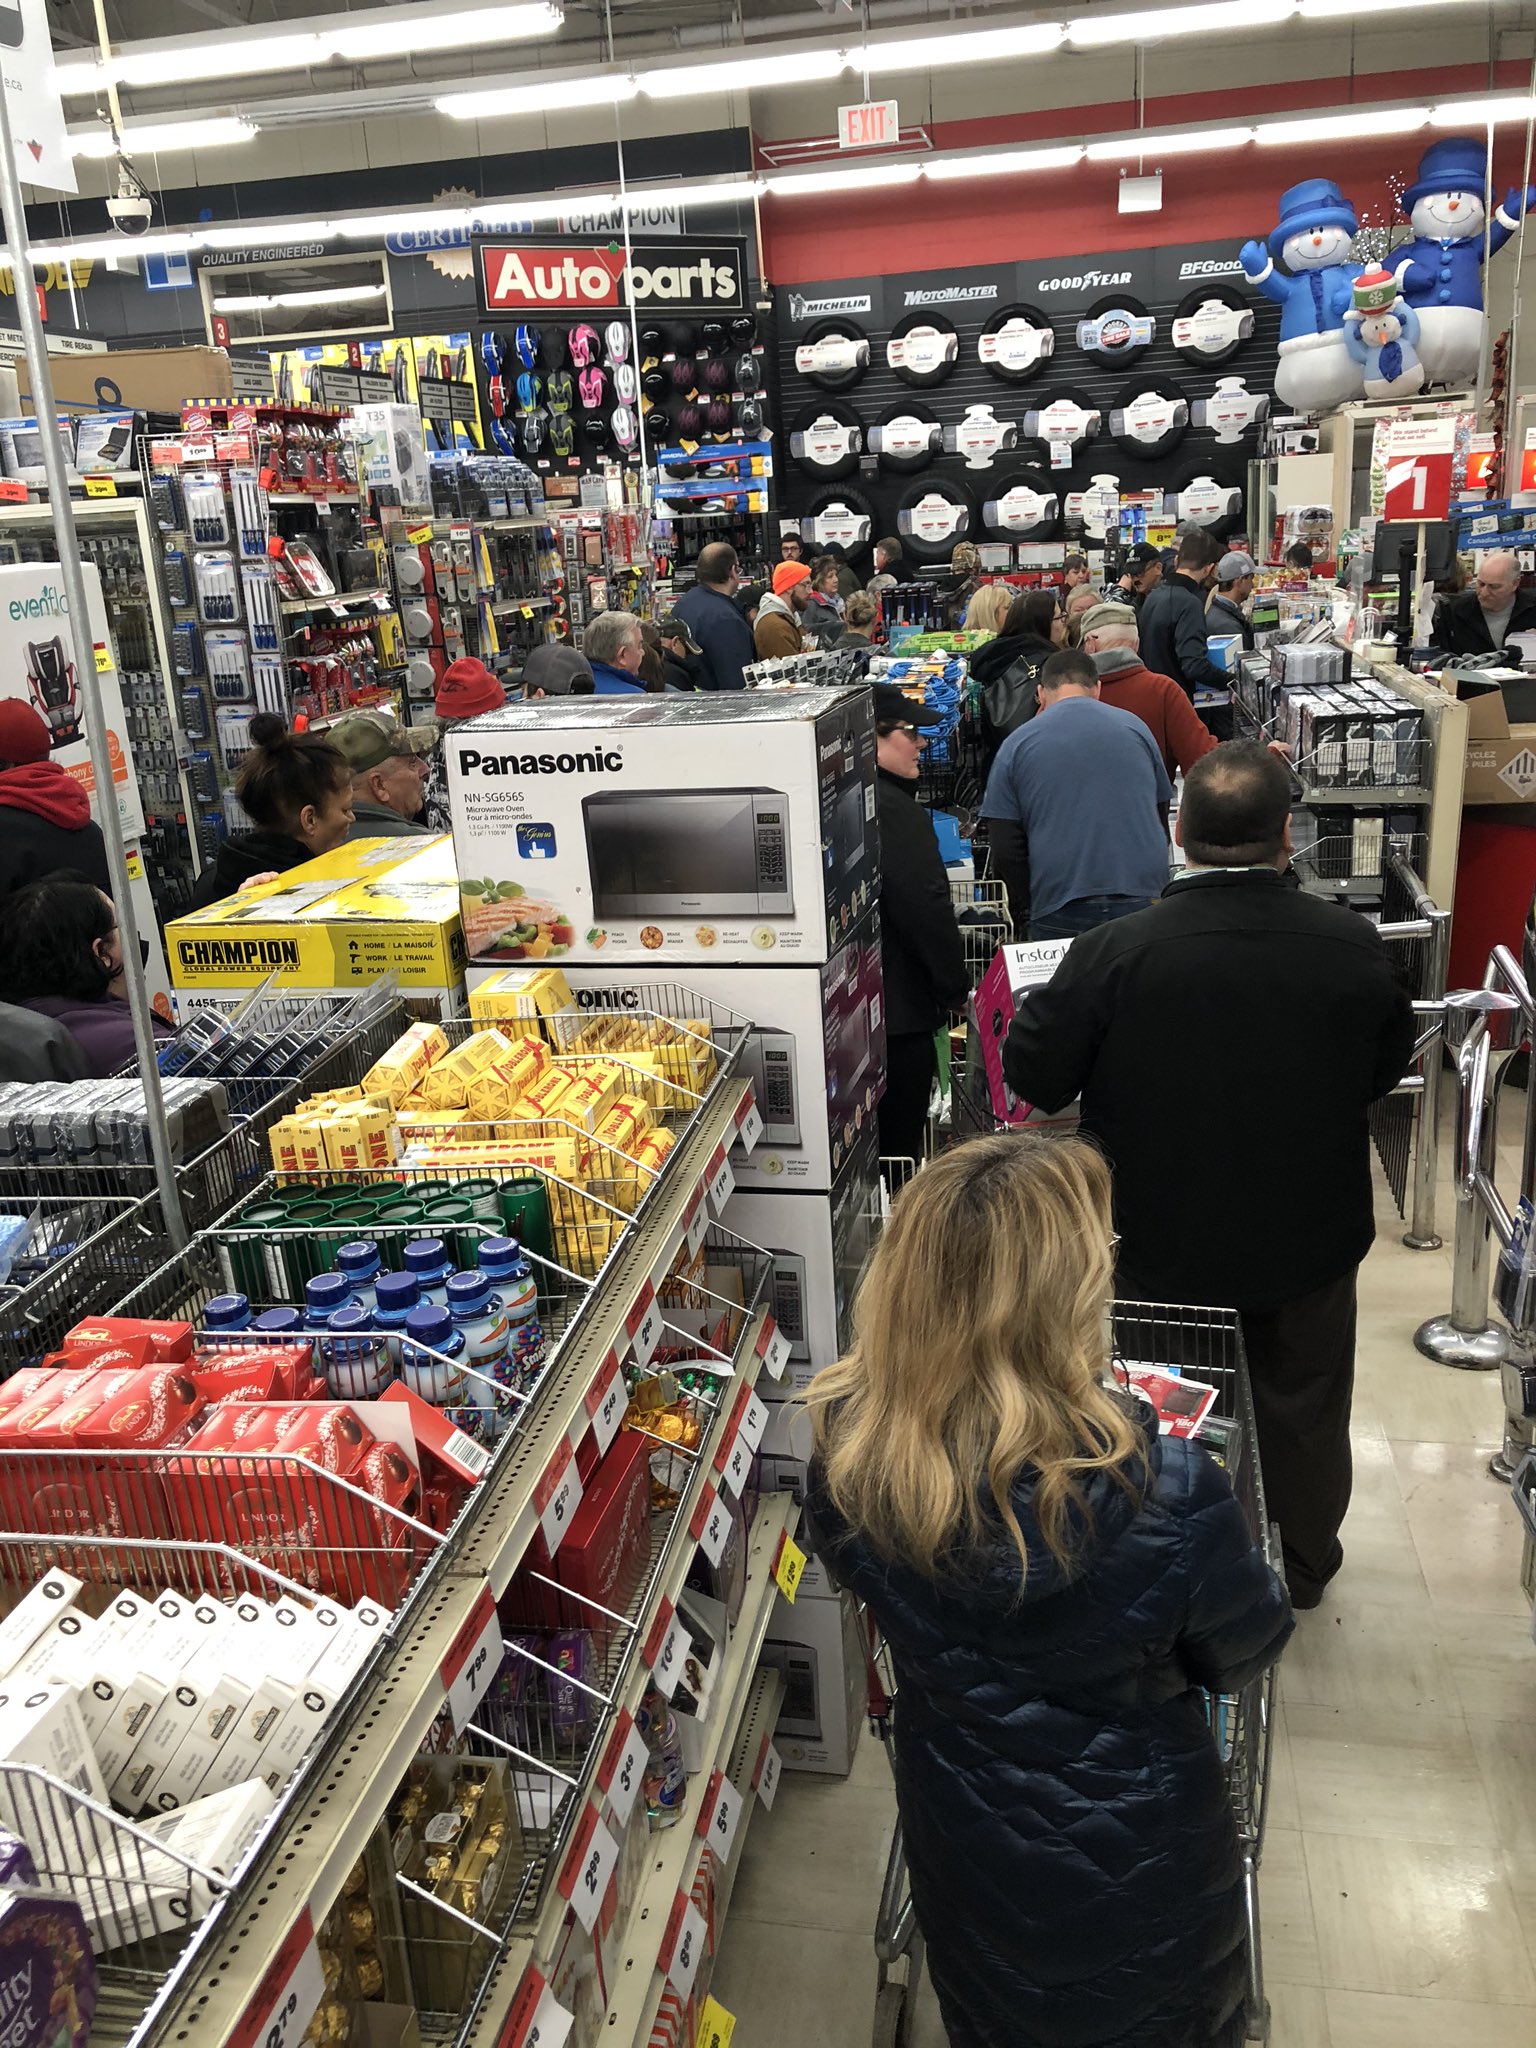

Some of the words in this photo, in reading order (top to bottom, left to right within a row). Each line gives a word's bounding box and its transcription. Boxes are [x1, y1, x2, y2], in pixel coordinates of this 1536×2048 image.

[847, 106, 887, 144] EXIT
[201, 250, 249, 267] QUALITY
[251, 243, 325, 262] ENGINEERED
[494, 252, 611, 300] Auto
[624, 257, 737, 306] parts
[1037, 270, 1132, 293] GOODYEAR
[806, 297, 868, 313] MICHELIN
[8, 333, 24, 343] META
[217, 322, 227, 340] 3
[61, 339, 74, 349] TIRE
[74, 341, 94, 351] REPAIR
[351, 348, 360, 362] 2
[366, 410, 386, 422] T35
[1412, 466, 1428, 511] 1
[1467, 535, 1500, 545] Canadian
[1502, 535, 1515, 543] Tire
[1517, 533, 1532, 542] Gift
[458, 745, 623, 776] Panasonic
[464, 791, 525, 803] NN-SG656S
[465, 805, 505, 813] Microwave
[505, 804, 525, 812] Oven
[489, 812, 533, 820] micro-ondes
[523, 827, 552, 841] Genius
[179, 940, 299, 965] CHAMPION
[571, 987, 639, 1009] onic
[554, 1483, 570, 1522] 599
[241, 1513, 286, 1523] LNDOR
[465, 1646, 487, 1693] 799
[620, 1753, 635, 1792] 349
[717, 1801, 729, 1834] 599
[585, 1850, 601, 1896] 299
[680, 1930, 692, 1969] 899
[264, 1992, 297, 2048] 279
